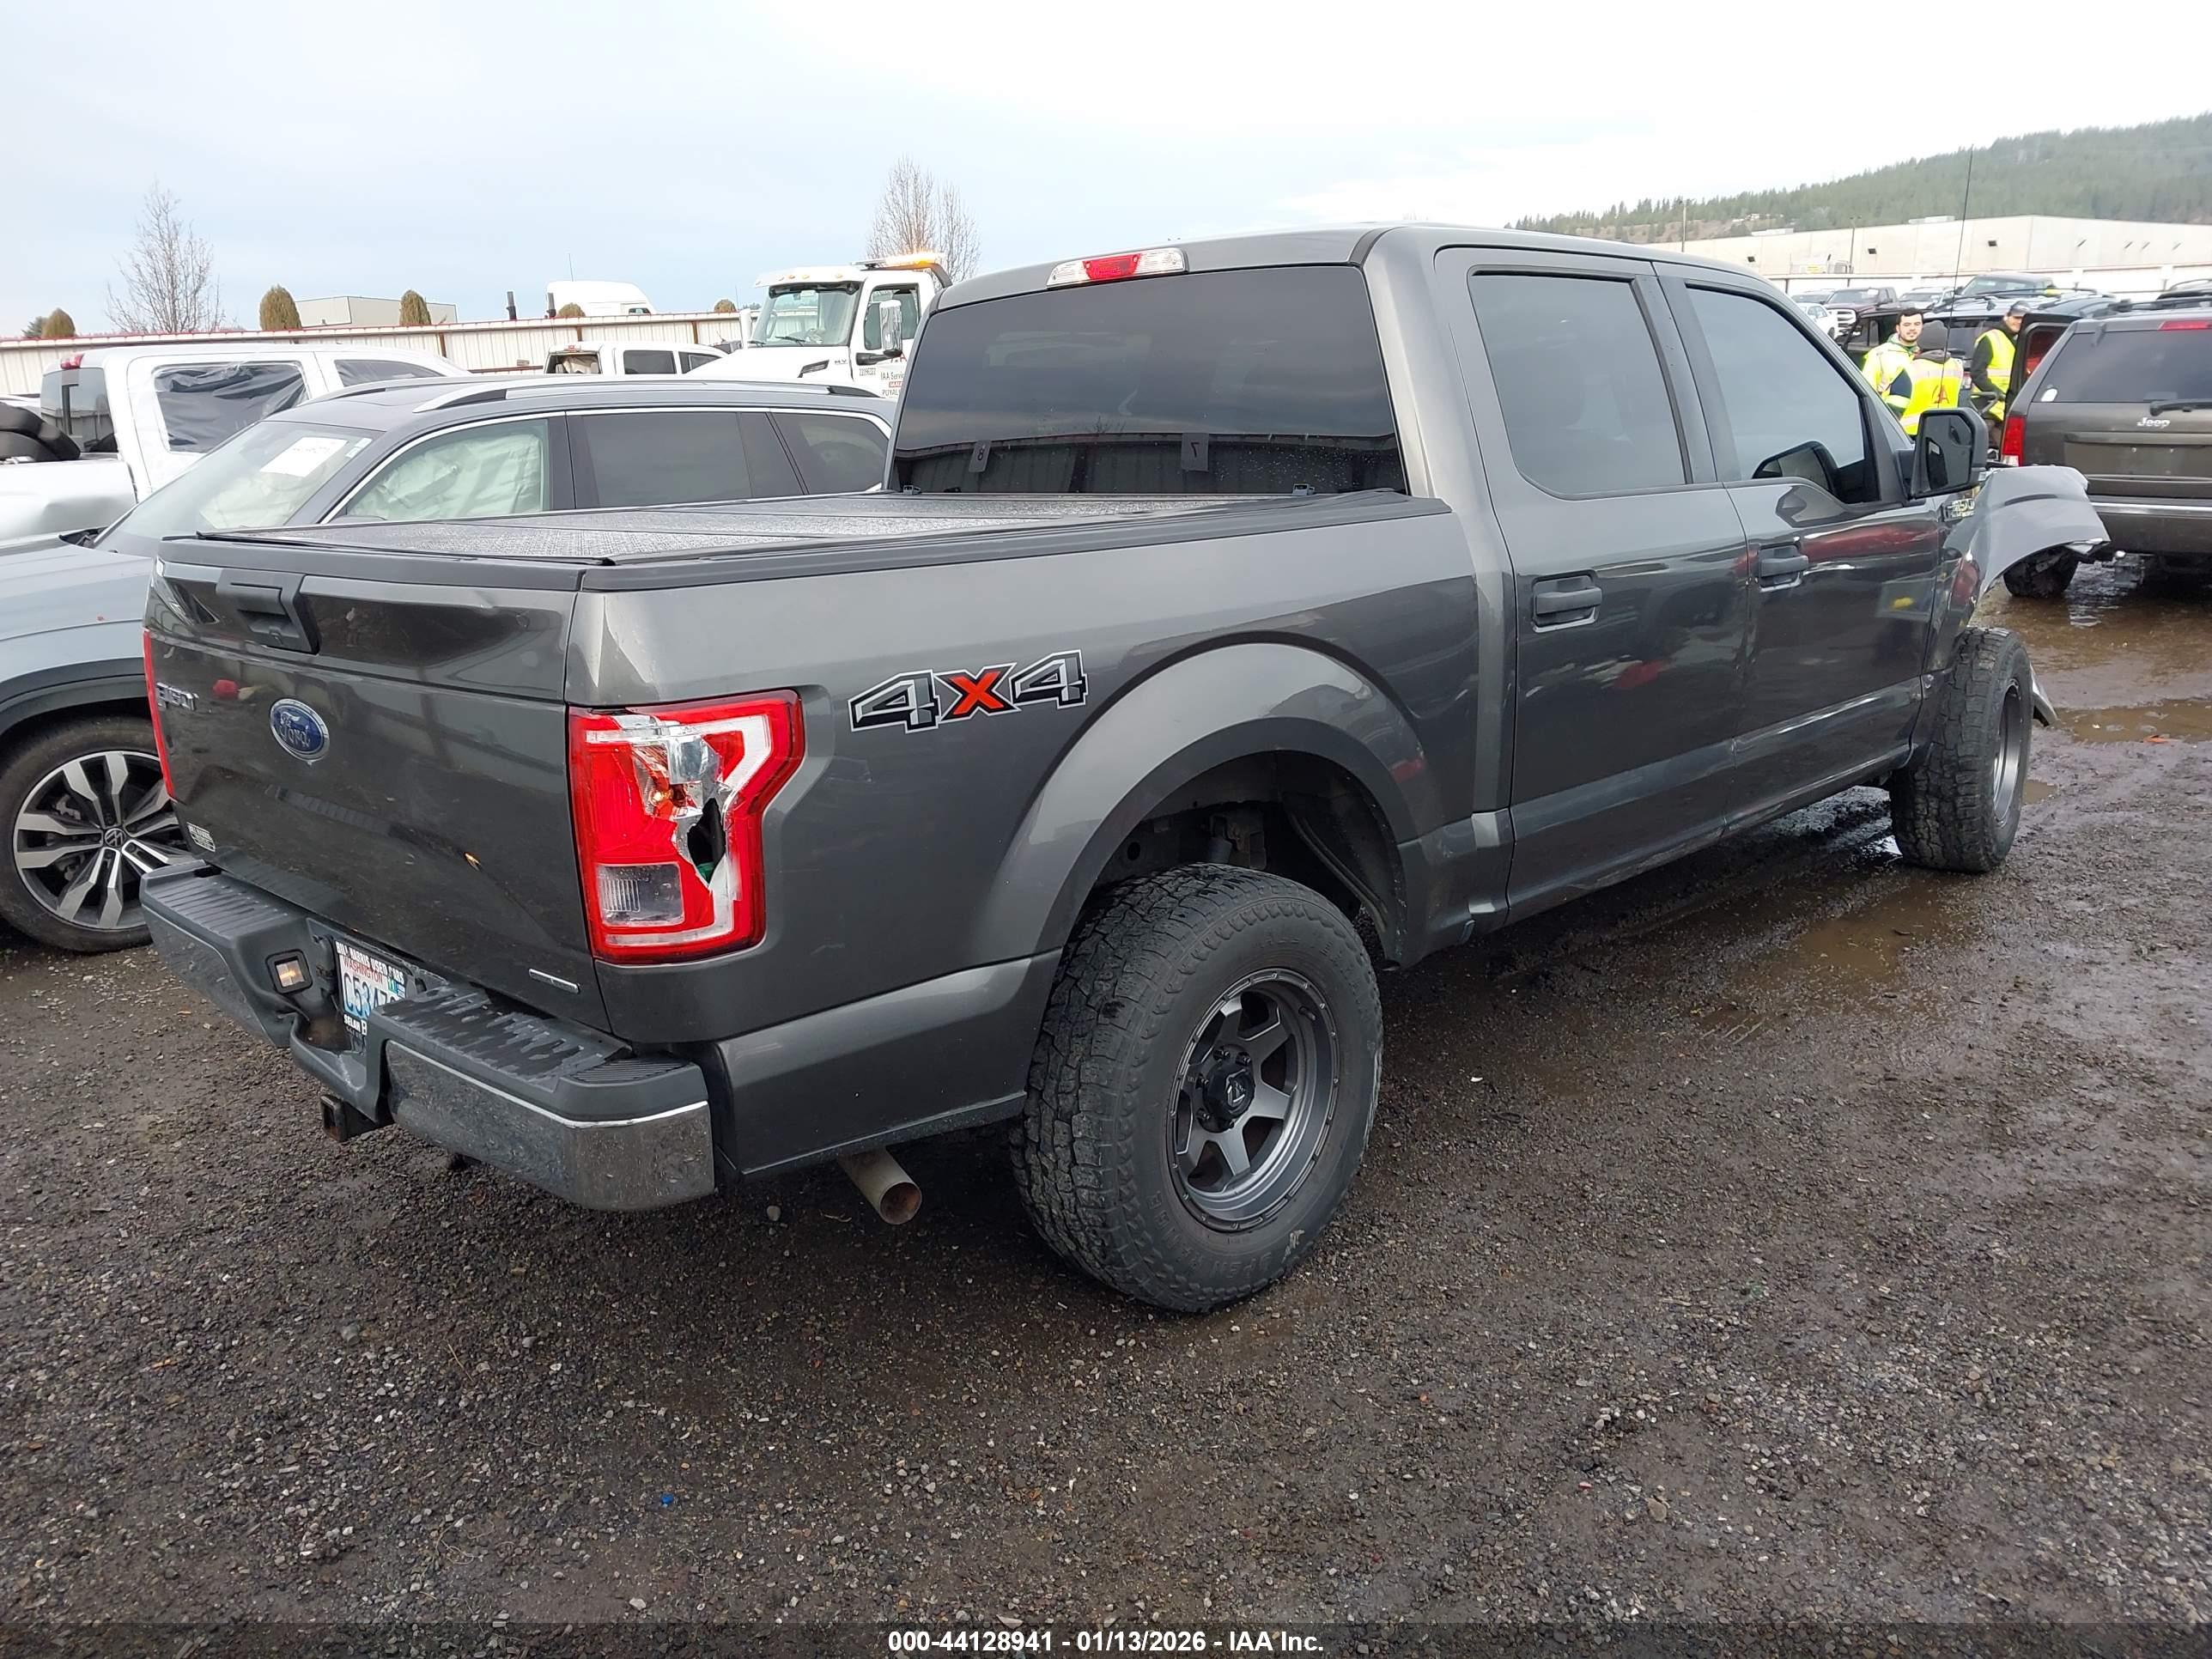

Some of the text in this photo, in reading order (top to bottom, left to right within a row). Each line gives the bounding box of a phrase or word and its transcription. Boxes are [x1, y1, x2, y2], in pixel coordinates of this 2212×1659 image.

[2136, 416, 2171, 429] Jeep
[848, 649, 1089, 734] 4X4
[279, 710, 312, 748] Ford
[343, 957, 384, 984] WASHINGTON
[370, 957, 388, 976] USED
